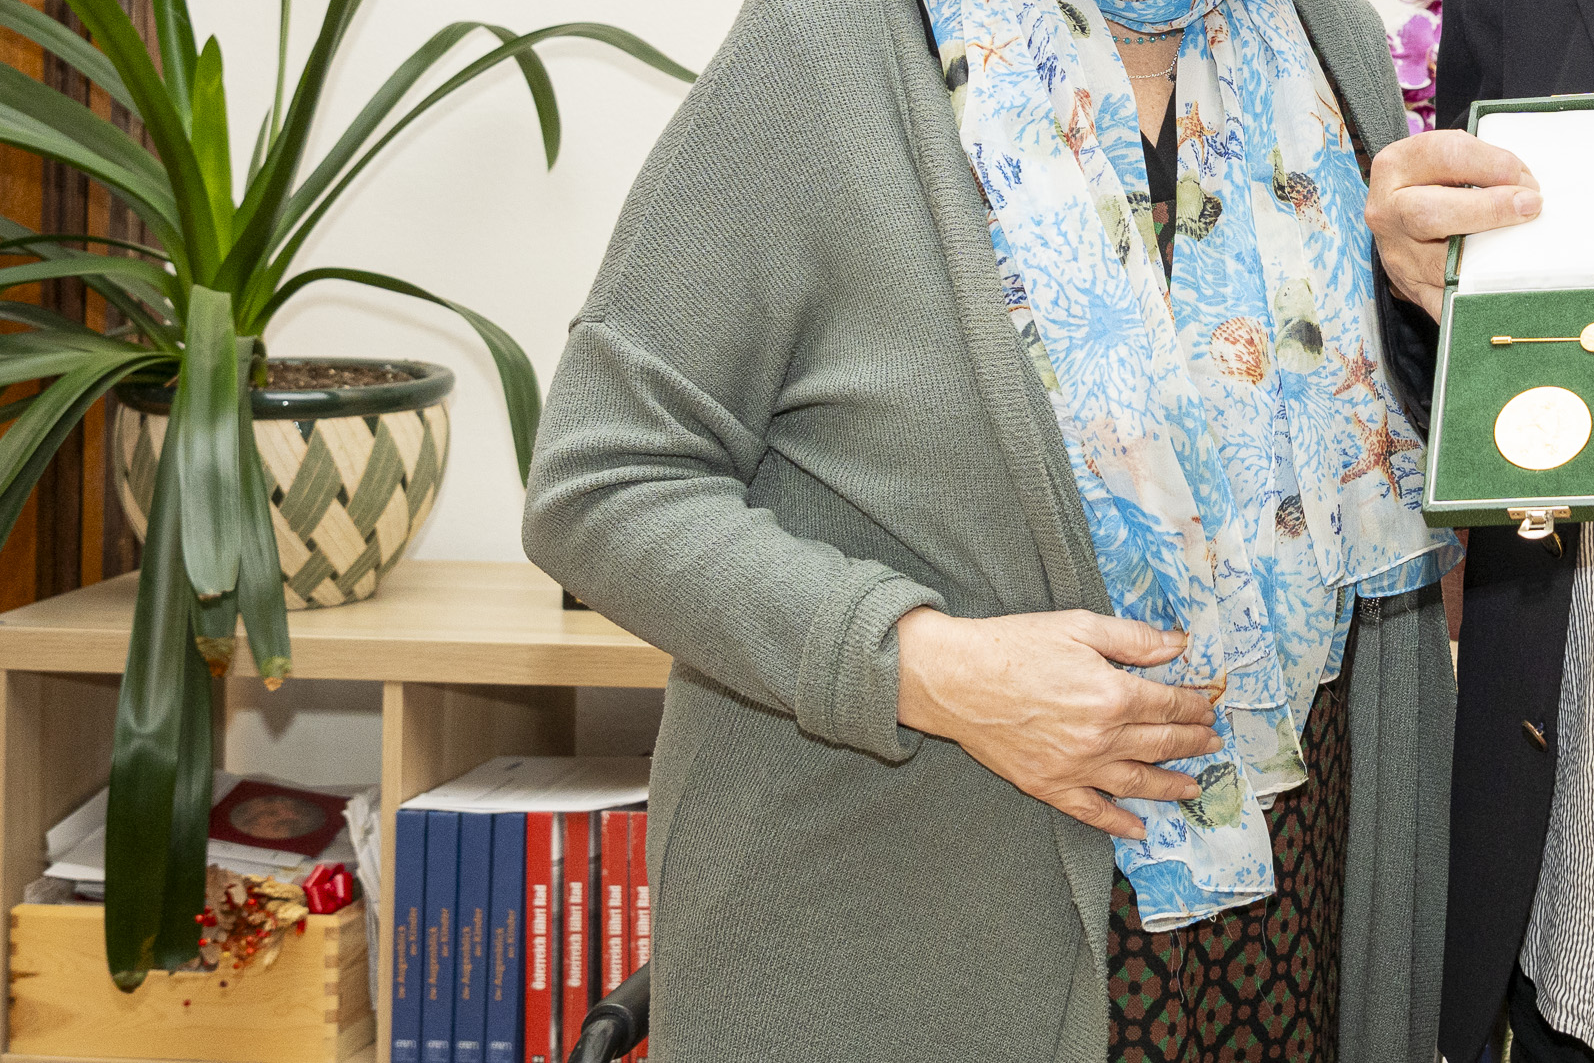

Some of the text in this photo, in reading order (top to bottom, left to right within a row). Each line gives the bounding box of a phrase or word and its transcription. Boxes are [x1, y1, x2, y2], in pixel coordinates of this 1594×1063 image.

[533, 884, 547, 906] Rad
[569, 882, 583, 903] Rad
[609, 885, 622, 907] Rad
[531, 936, 547, 991] Österreich
[567, 934, 583, 988] Österreich
